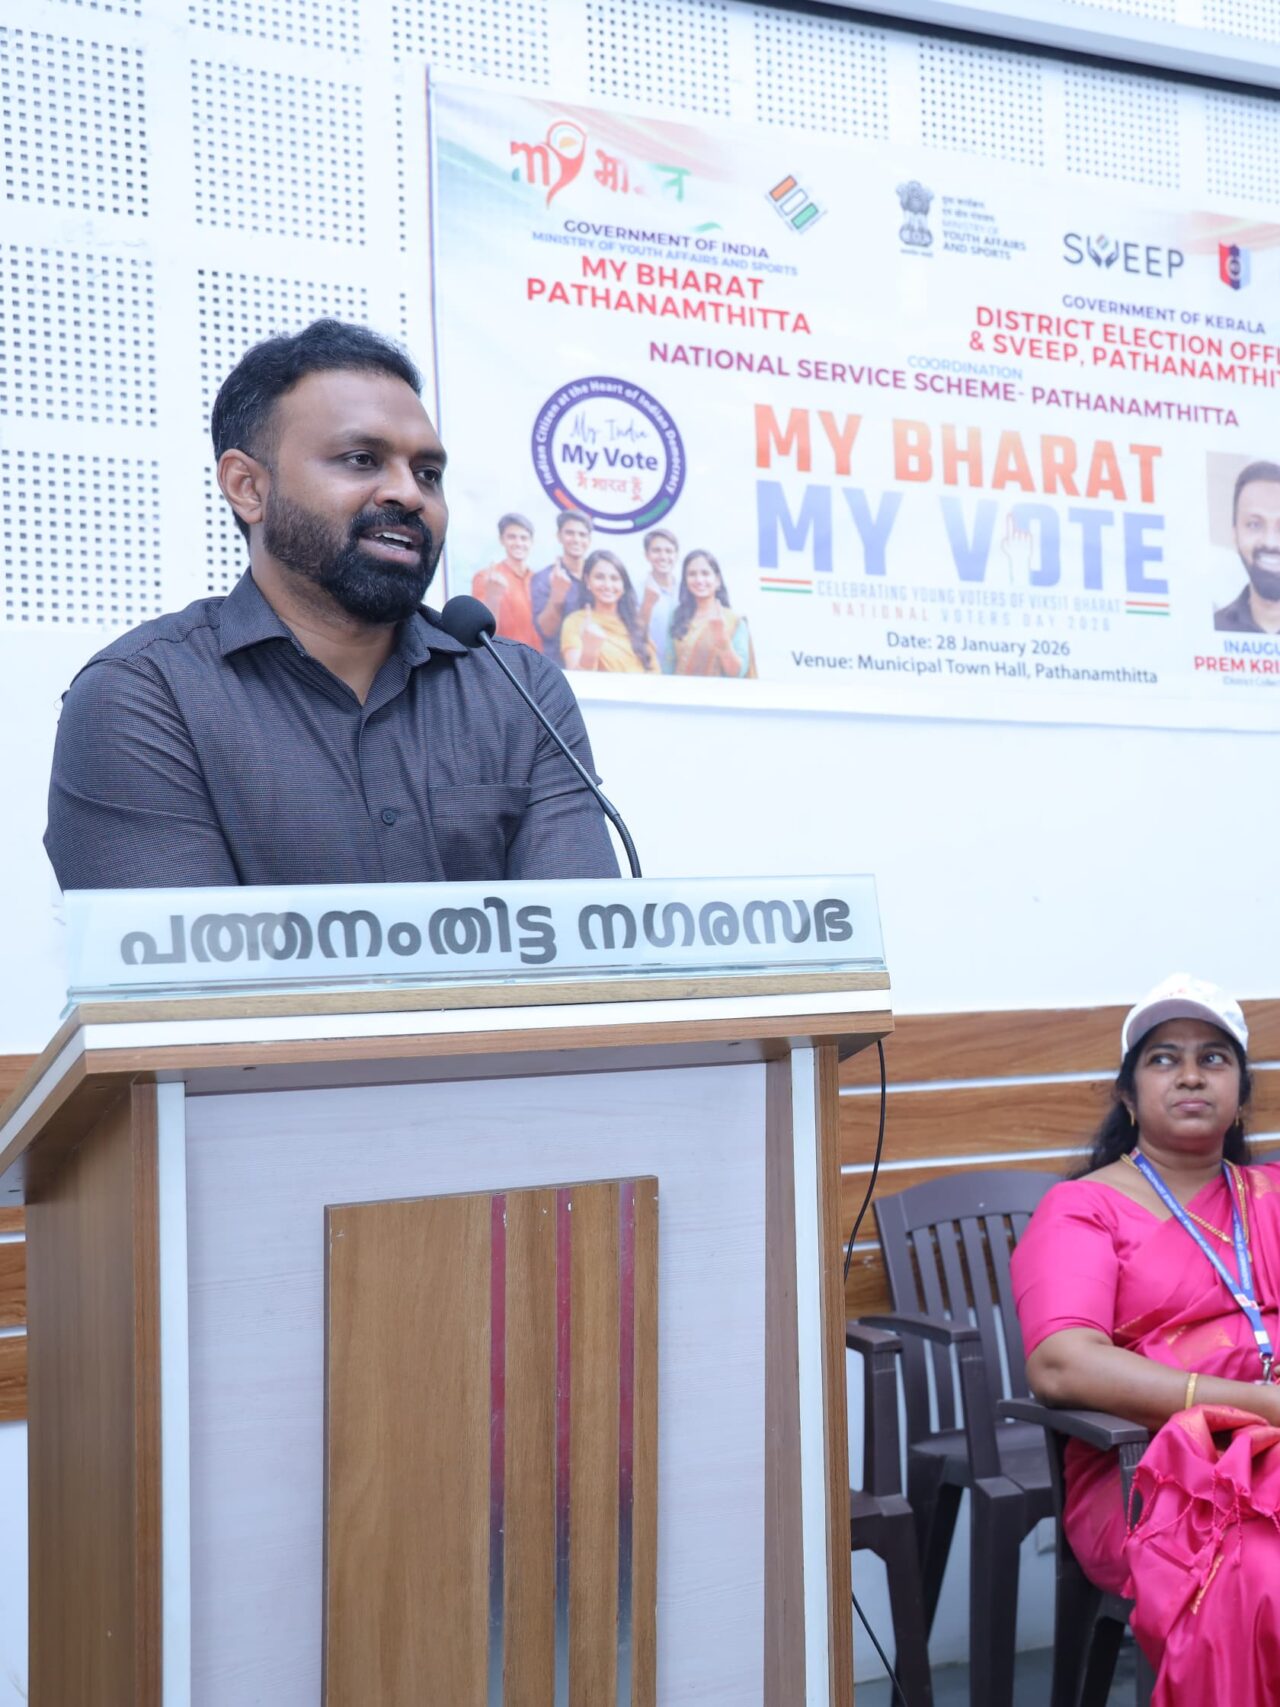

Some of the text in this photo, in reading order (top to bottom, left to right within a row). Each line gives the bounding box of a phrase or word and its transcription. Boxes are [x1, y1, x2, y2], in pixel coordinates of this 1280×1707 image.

[532, 231, 799, 277] MINISTRY OF YOUTH AFFAIRS AND SPORTS
[564, 220, 770, 259] GOVERNMENT OF INDIA
[943, 242, 968, 254] AND
[581, 255, 765, 300] MY BHARAT
[527, 277, 812, 335] PATHANAMTHITTA
[1062, 294, 1266, 335] GOVERNMENT OF KERALA
[969, 331, 986, 351] &
[994, 334, 1085, 367] SVEEP,
[976, 305, 1094, 341] DISTRICT
[1103, 323, 1222, 356] ELECTION
[649, 341, 790, 377] NATIONAL
[797, 358, 906, 390] SERVICE
[1031, 386, 1239, 427] PATHANAMTHITTA
[907, 354, 1024, 381] COORDINATION
[562, 443, 658, 471] My Vote
[754, 403, 1163, 504] MY BHARAT
[756, 479, 1170, 595] MY VOTE
[817, 579, 908, 601] CELEBRATING
[832, 601, 929, 623] NATIONAL
[887, 631, 1071, 657] Date: 28 January 2026
[792, 651, 1158, 685] Venue: Municipal Town Hall, Pathanamthitta
[1194, 655, 1245, 673] PREM
[120, 896, 854, 965] പത്തനംതിട്ട നഗരസഭ
